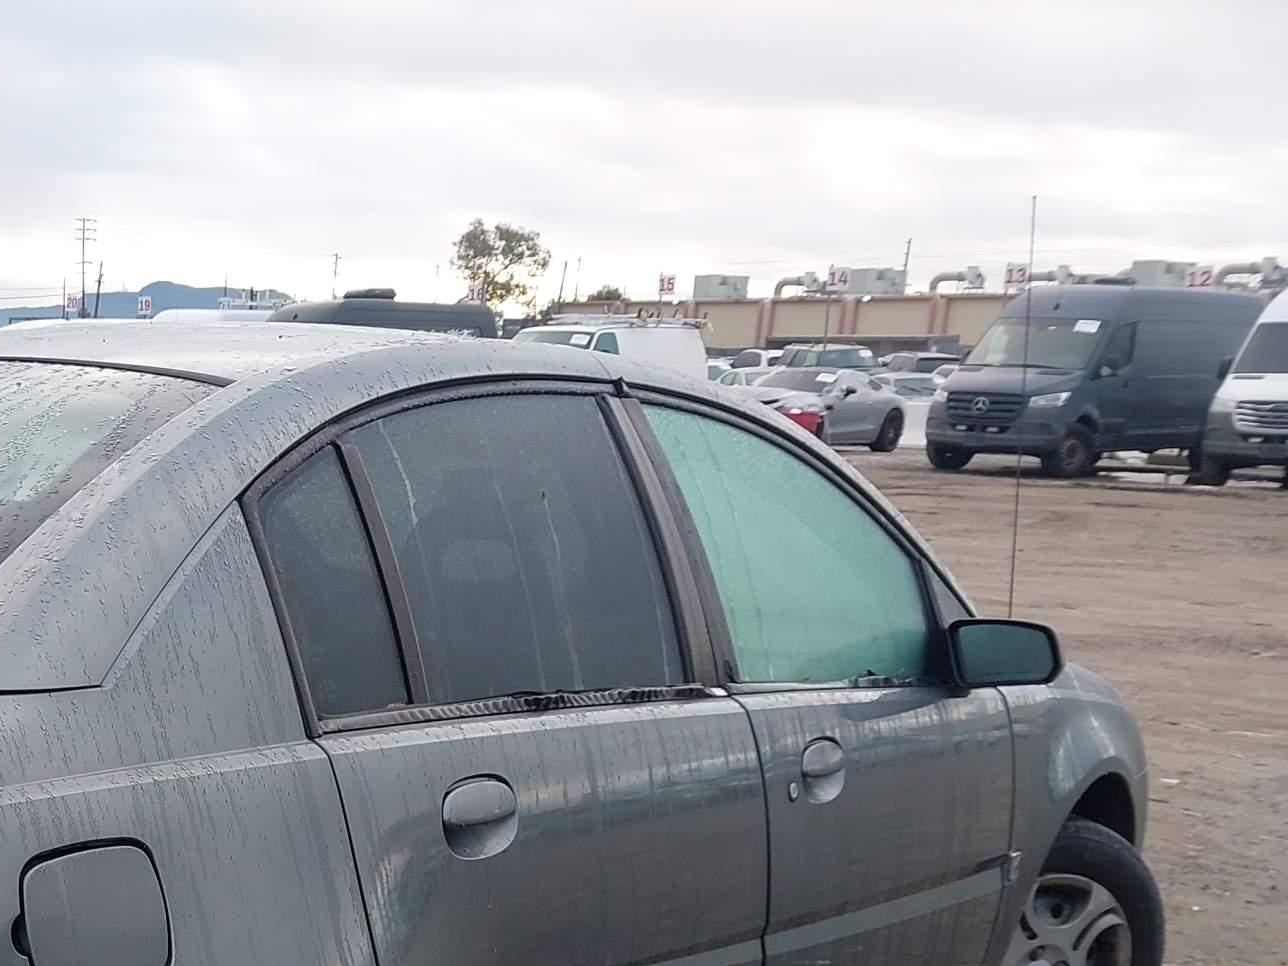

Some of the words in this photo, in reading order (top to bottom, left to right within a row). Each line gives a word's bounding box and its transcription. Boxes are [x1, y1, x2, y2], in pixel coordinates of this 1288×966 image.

[658, 275, 676, 292] 15
[827, 271, 849, 287] 14
[1004, 267, 1027, 284] 13
[1186, 270, 1212, 288] 12
[468, 287, 485, 301] 16
